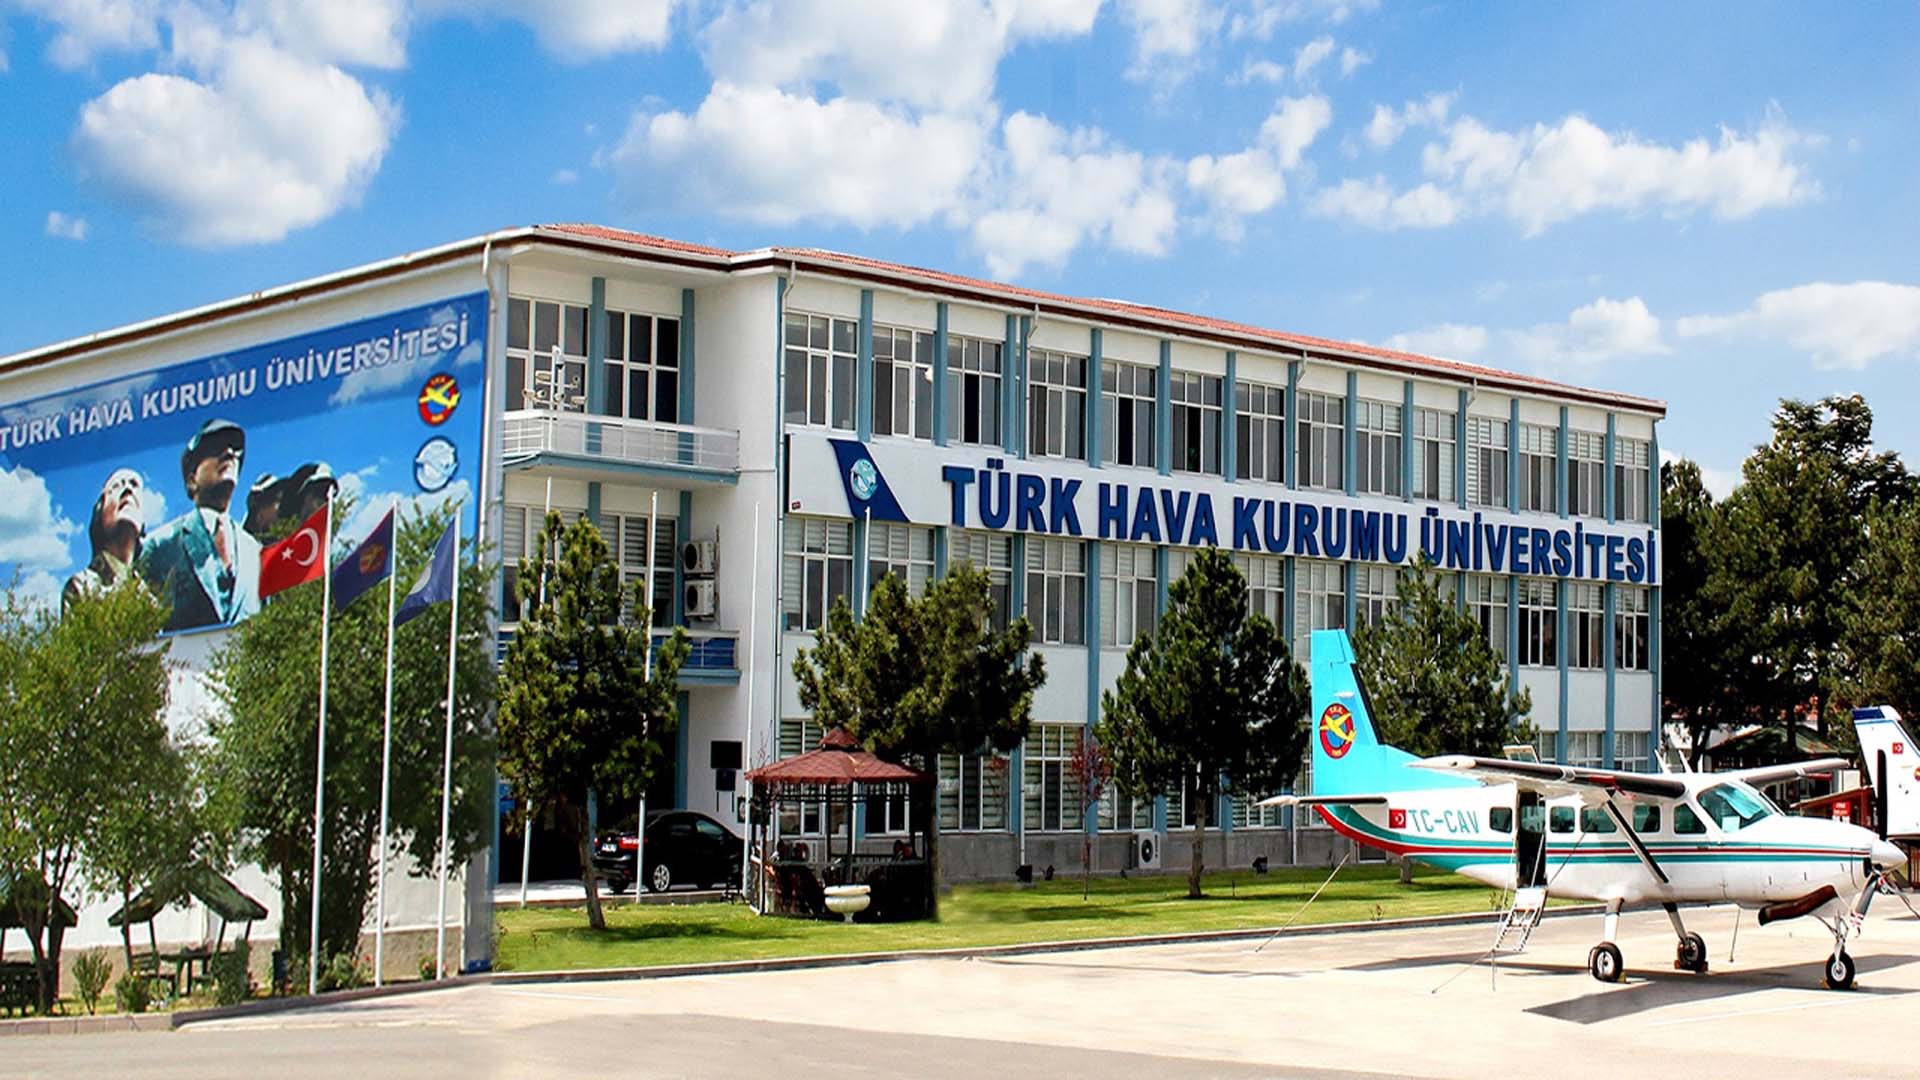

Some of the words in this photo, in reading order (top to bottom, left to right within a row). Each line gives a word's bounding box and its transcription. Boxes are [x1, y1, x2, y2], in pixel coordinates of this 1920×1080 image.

[0, 414, 61, 451] TÜRK
[69, 399, 134, 435] HAVA
[142, 367, 257, 418] KURUMU
[266, 313, 469, 390] ÜNİVERSİTESİ
[942, 458, 1083, 536] TÜRK
[1098, 482, 1219, 547] HAVA
[1232, 496, 1408, 564] KURUMU
[1420, 507, 1657, 584] ÜNİVERSİTESİ
[1408, 808, 1481, 835] TC-CAV
